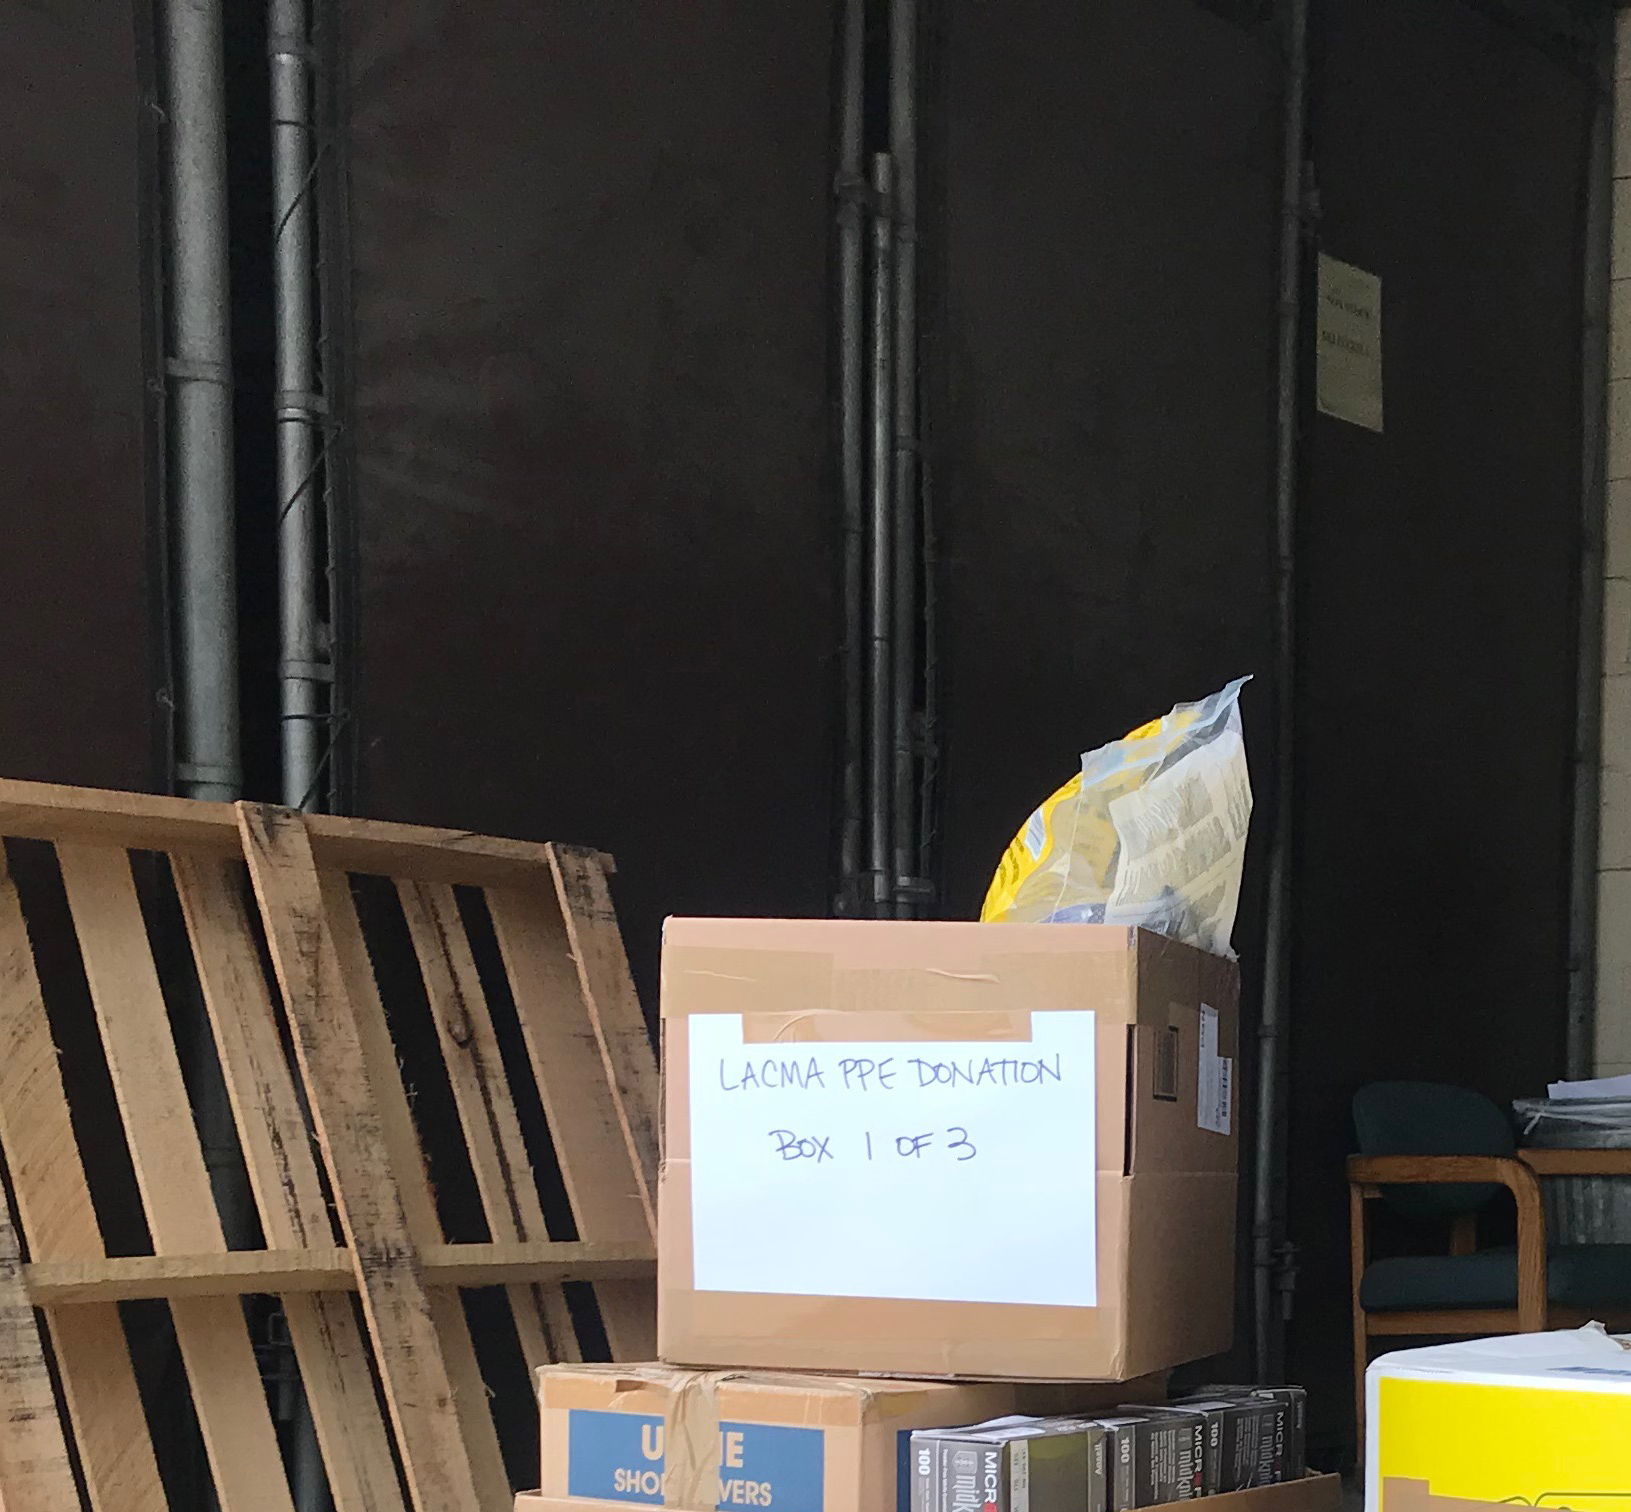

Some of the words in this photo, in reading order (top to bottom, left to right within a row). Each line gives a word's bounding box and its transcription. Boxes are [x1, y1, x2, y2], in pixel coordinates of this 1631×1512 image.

[719, 1057, 825, 1091] LACMA
[837, 1058, 897, 1091] PPE
[907, 1053, 1062, 1088] DONATION
[864, 1132, 873, 1160] 1
[896, 1132, 934, 1159] OF
[946, 1126, 977, 1161] 3
[1210, 1421, 1219, 1447] 100
[918, 1447, 931, 1476] 100
[1120, 1437, 1131, 1463] 100
[718, 1478, 773, 1507] VERS
